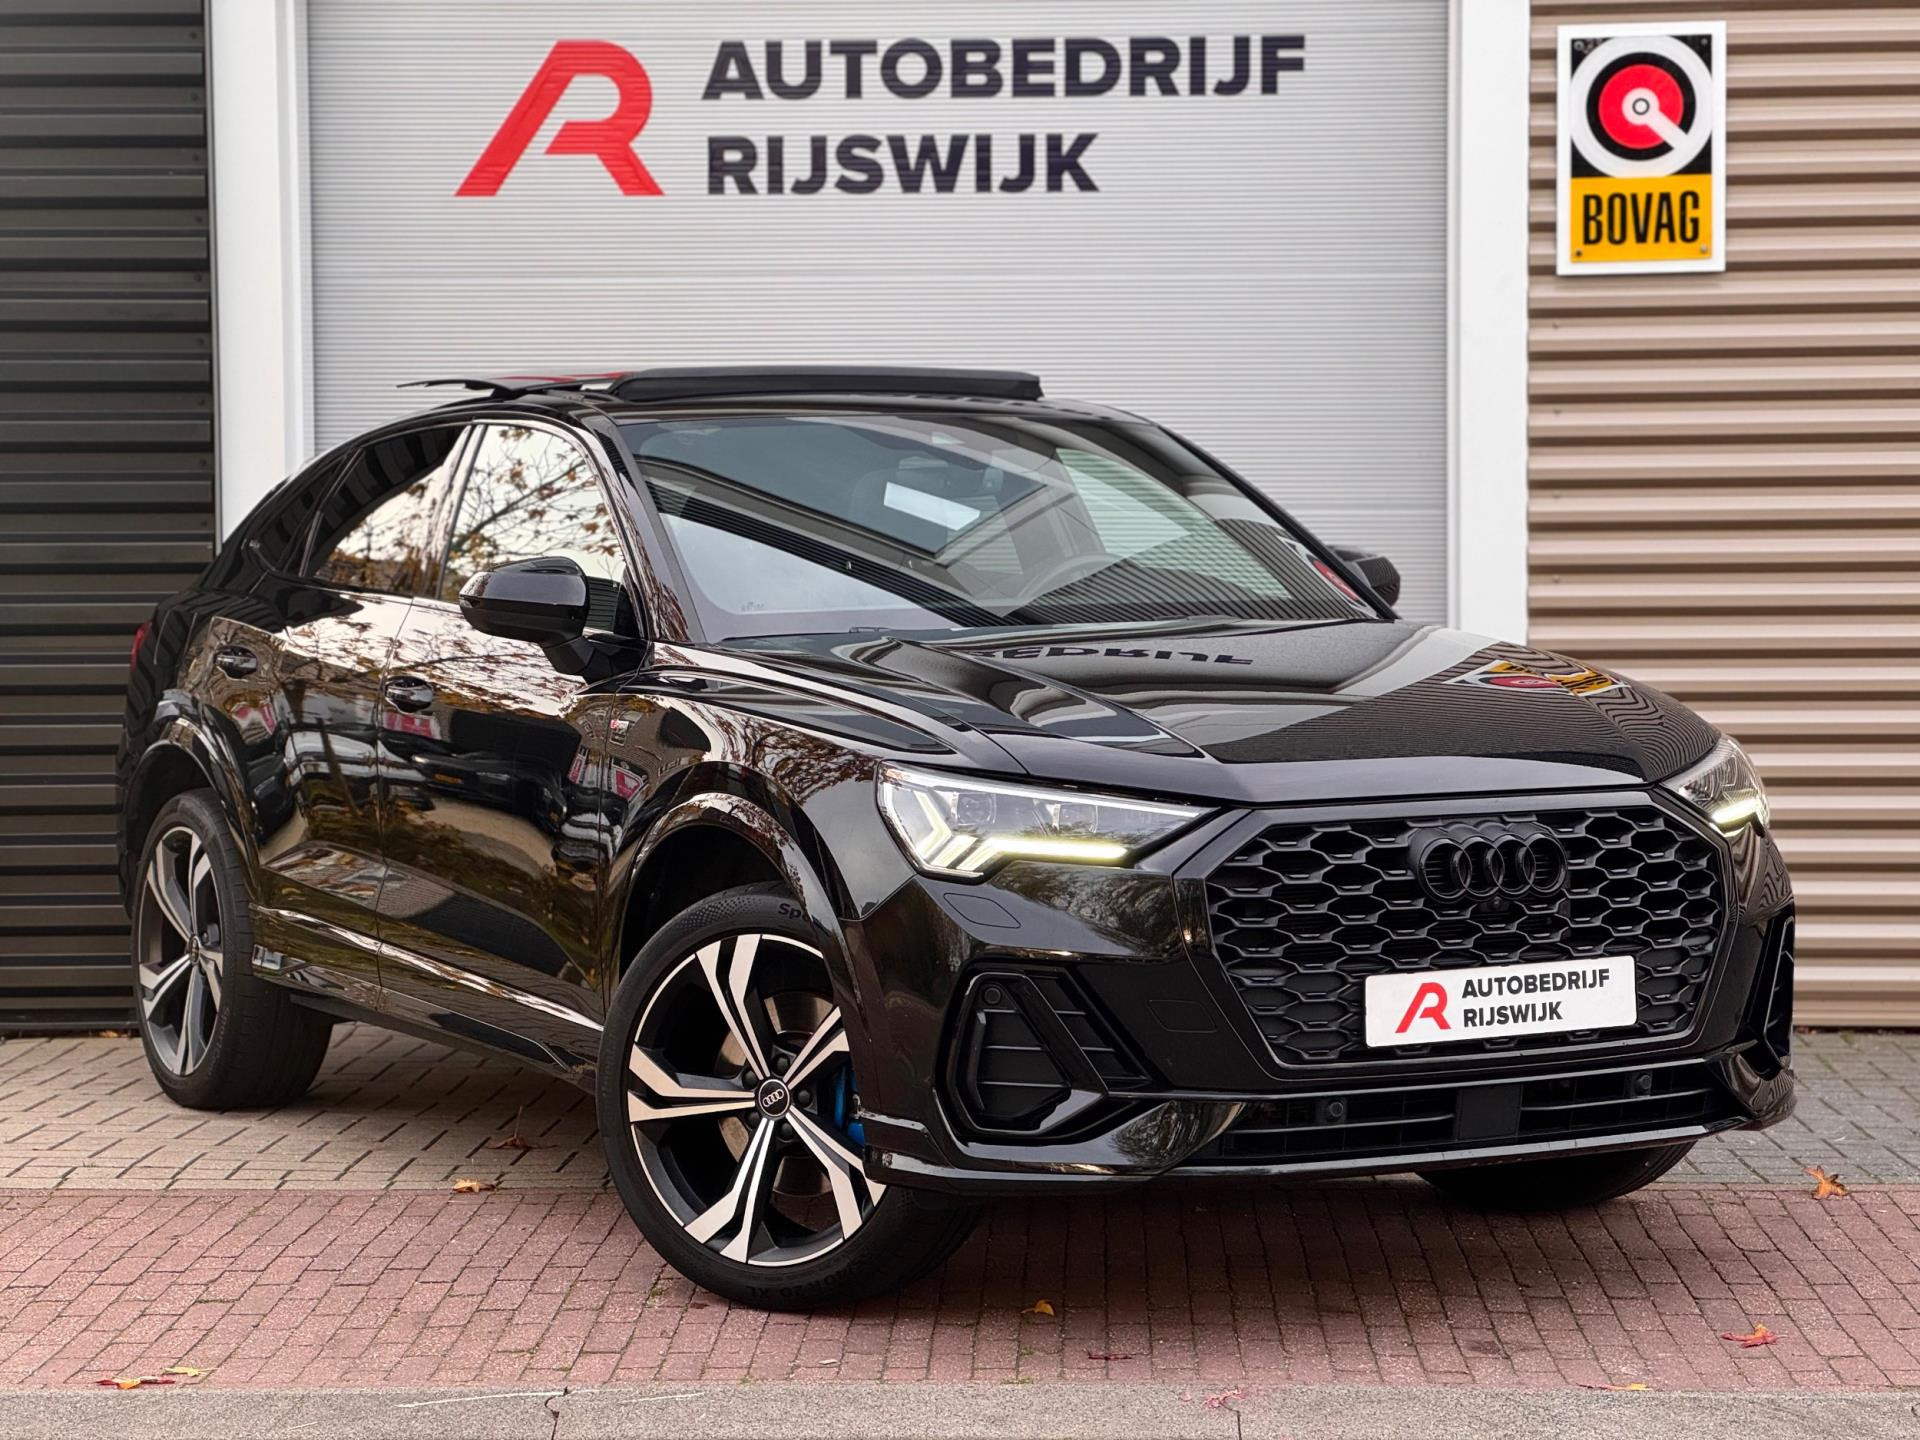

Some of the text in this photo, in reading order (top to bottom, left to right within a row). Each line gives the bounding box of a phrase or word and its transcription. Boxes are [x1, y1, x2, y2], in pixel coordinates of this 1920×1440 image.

[702, 35, 1306, 101] AUTOBEDRIJF
[708, 134, 1099, 195] RIJSWIJK
[1583, 191, 1700, 245] BOVAG
[1461, 968, 1611, 999] AUTOBEDRIJF
[1463, 1002, 1563, 1028] RIJSWIJK
